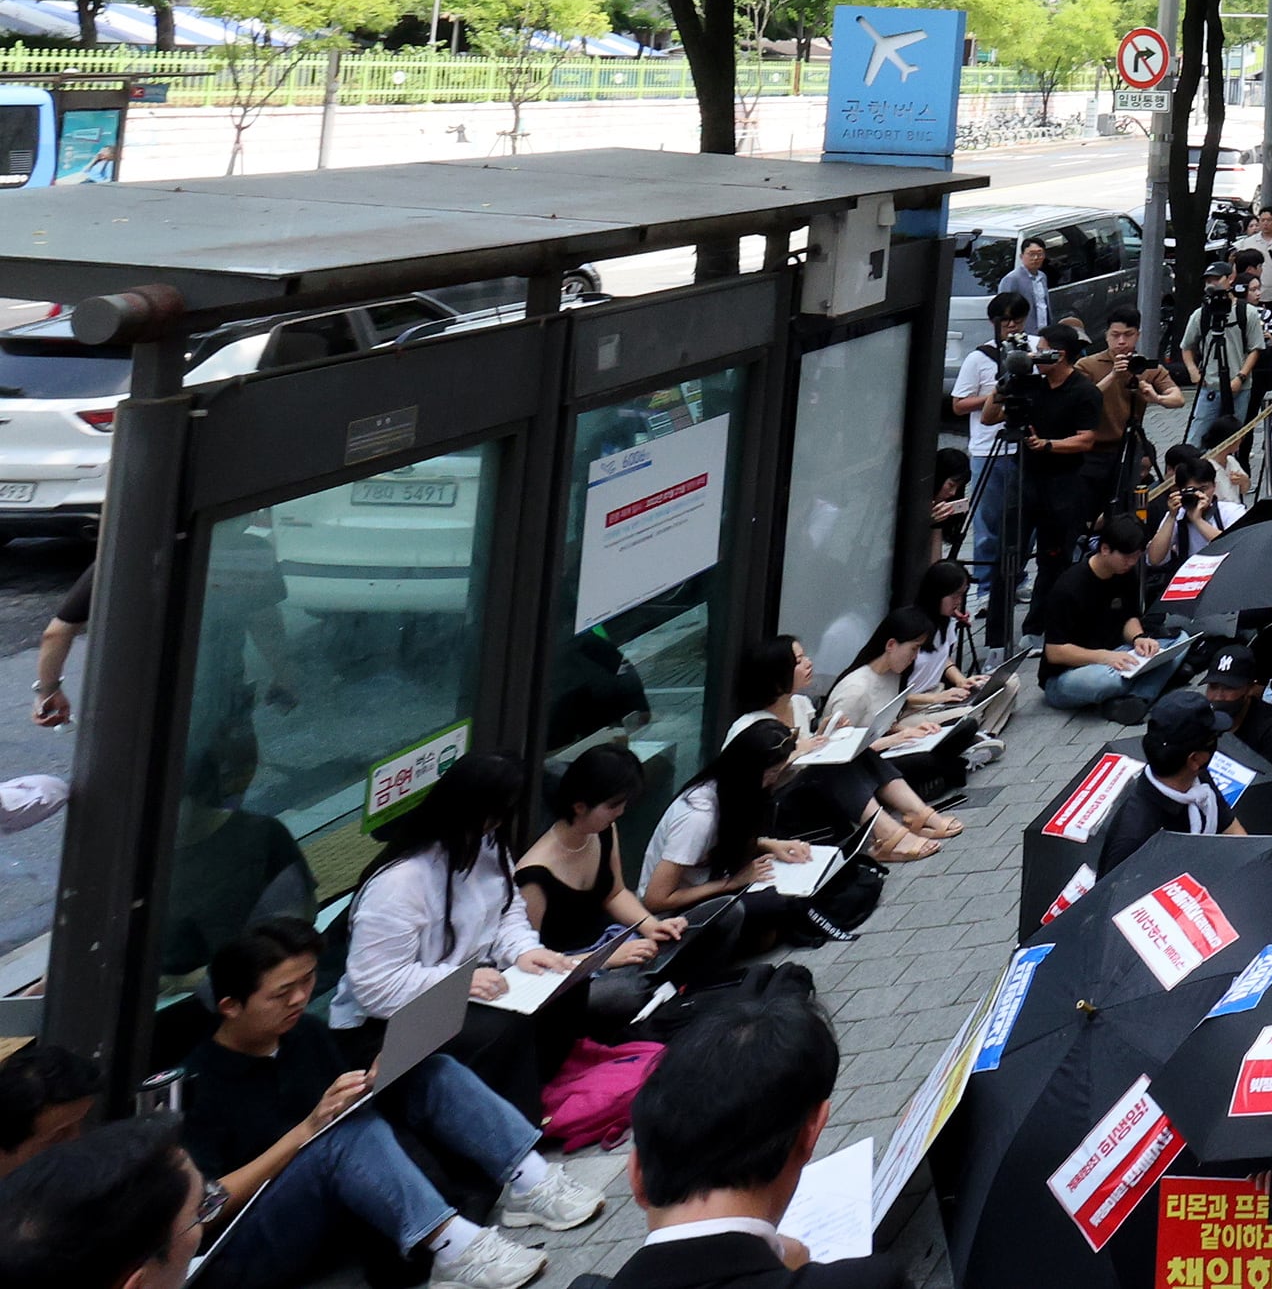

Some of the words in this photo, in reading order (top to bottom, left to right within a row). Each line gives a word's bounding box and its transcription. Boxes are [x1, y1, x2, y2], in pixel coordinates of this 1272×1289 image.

[1119, 94, 1165, 108] 일방통행
[841, 100, 937, 124] 공항버스
[841, 128, 901, 140] AIRPORT
[403, 485, 445, 501] 5491
[1097, 1097, 1149, 1158] 희생양!
[1166, 1194, 1228, 1220] 티몬과
